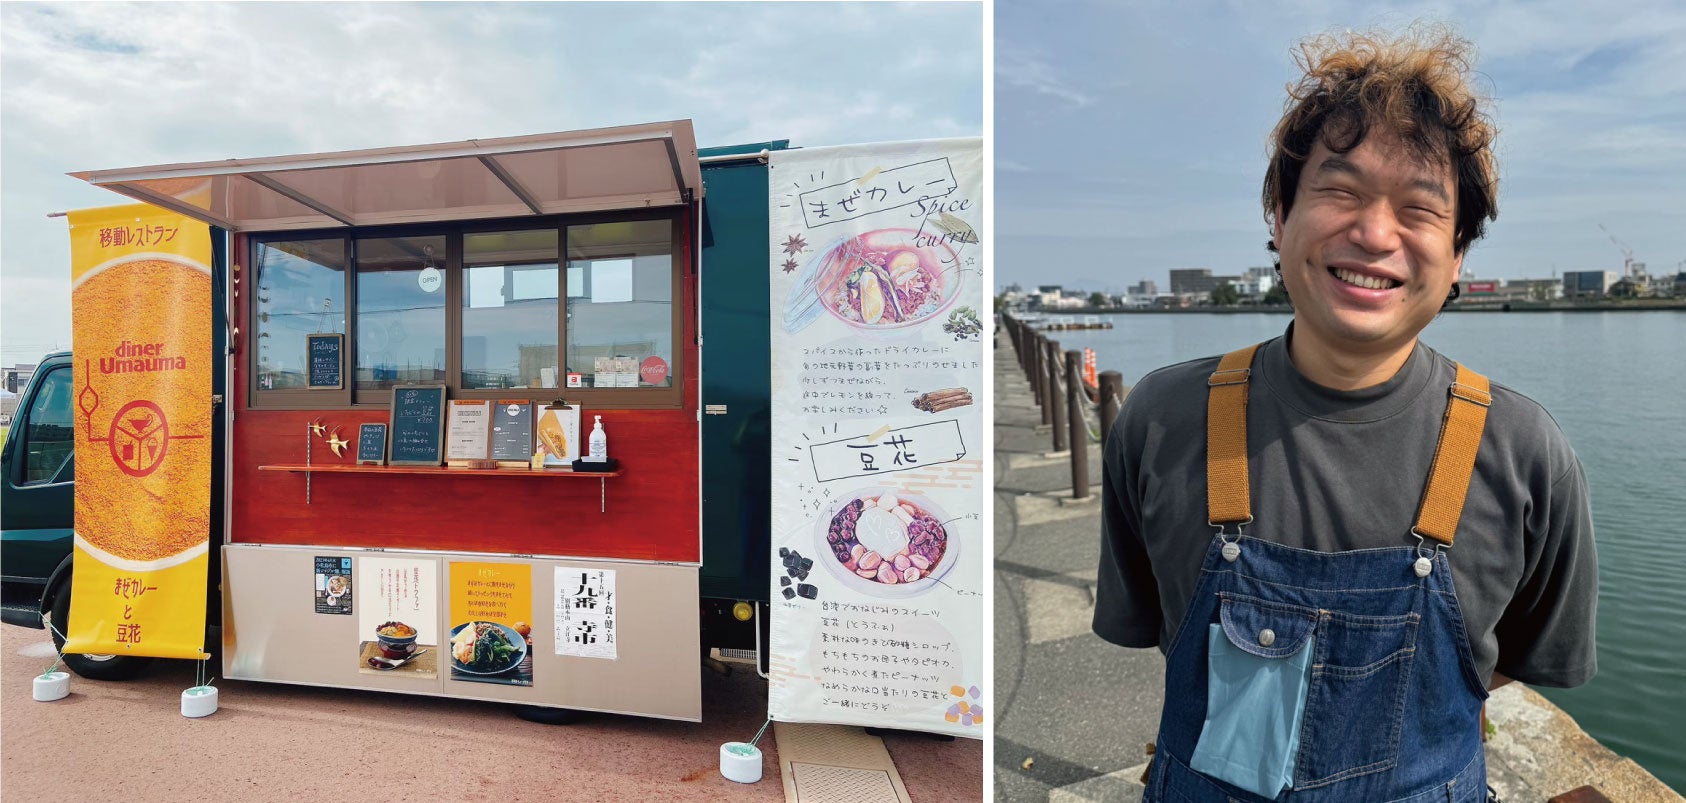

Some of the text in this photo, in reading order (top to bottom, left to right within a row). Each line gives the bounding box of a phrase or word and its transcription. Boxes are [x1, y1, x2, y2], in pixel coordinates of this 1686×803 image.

[809, 178, 946, 219] まぜカレー
[910, 195, 974, 240] Spice
[99, 224, 179, 248] 移動レストラン
[915, 229, 972, 264] curry
[114, 340, 165, 358] diner
[99, 355, 187, 375] Umauma
[846, 434, 917, 471] 豆花
[114, 577, 158, 600] まぜカレー
[123, 604, 133, 620] と
[821, 600, 940, 618] 台湾でおなじみのスイーツ
[115, 623, 141, 644] 豆花
[823, 666, 940, 683] やわらかく煮たピーナッツ
[821, 682, 949, 700] なめらかな口当たりの豆花と
[822, 698, 890, 712] ご一緒にどうぞ
